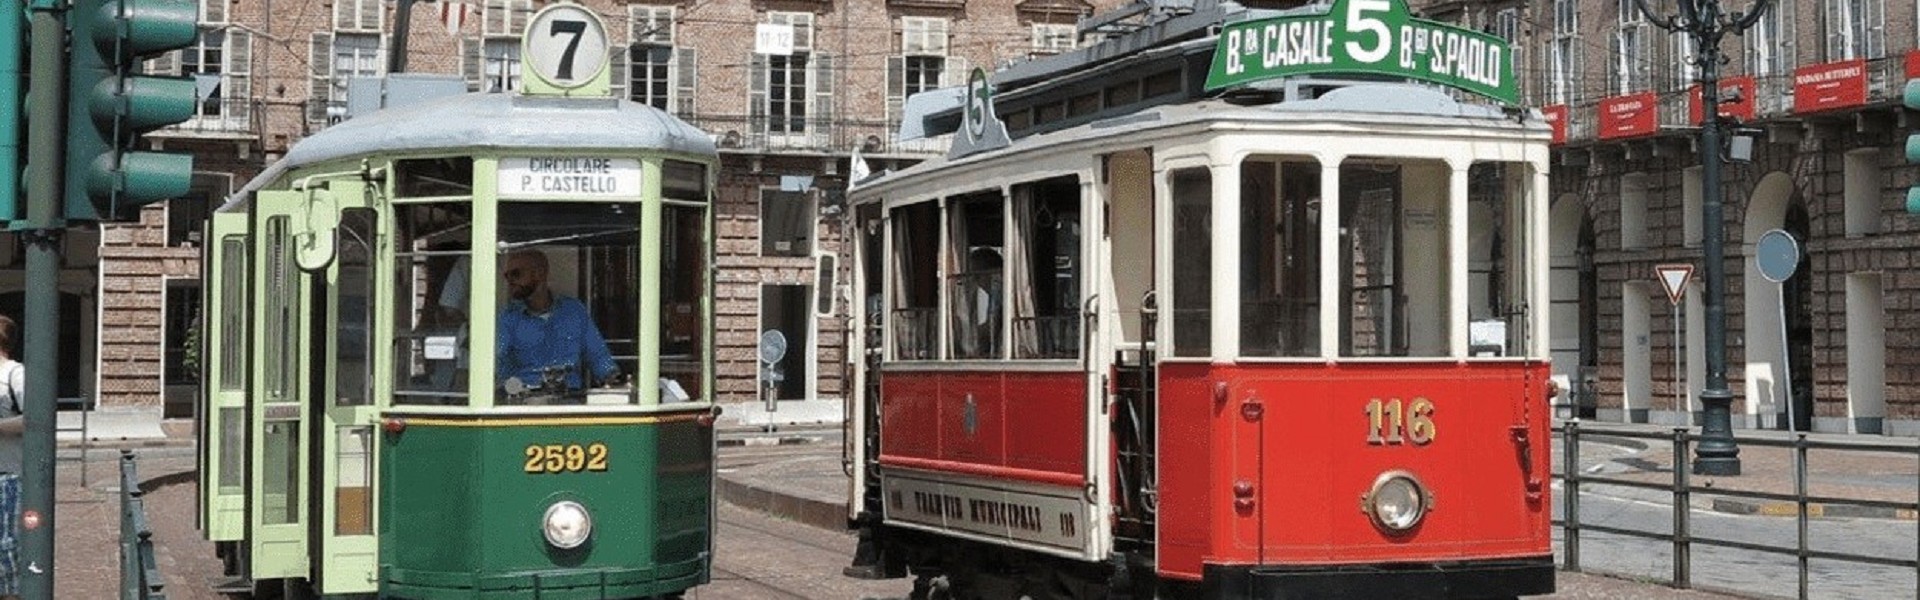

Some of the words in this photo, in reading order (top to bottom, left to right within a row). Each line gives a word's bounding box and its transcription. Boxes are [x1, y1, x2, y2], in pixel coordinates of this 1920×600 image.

[549, 20, 588, 79] 7
[1263, 20, 1334, 69] CASALE
[1345, 0, 1392, 63] 5
[970, 79, 985, 136] 5
[530, 157, 611, 174] CIRCOLARE
[541, 176, 617, 193] CASTELLO
[1364, 396, 1436, 446] 116
[523, 443, 609, 474] 2592
